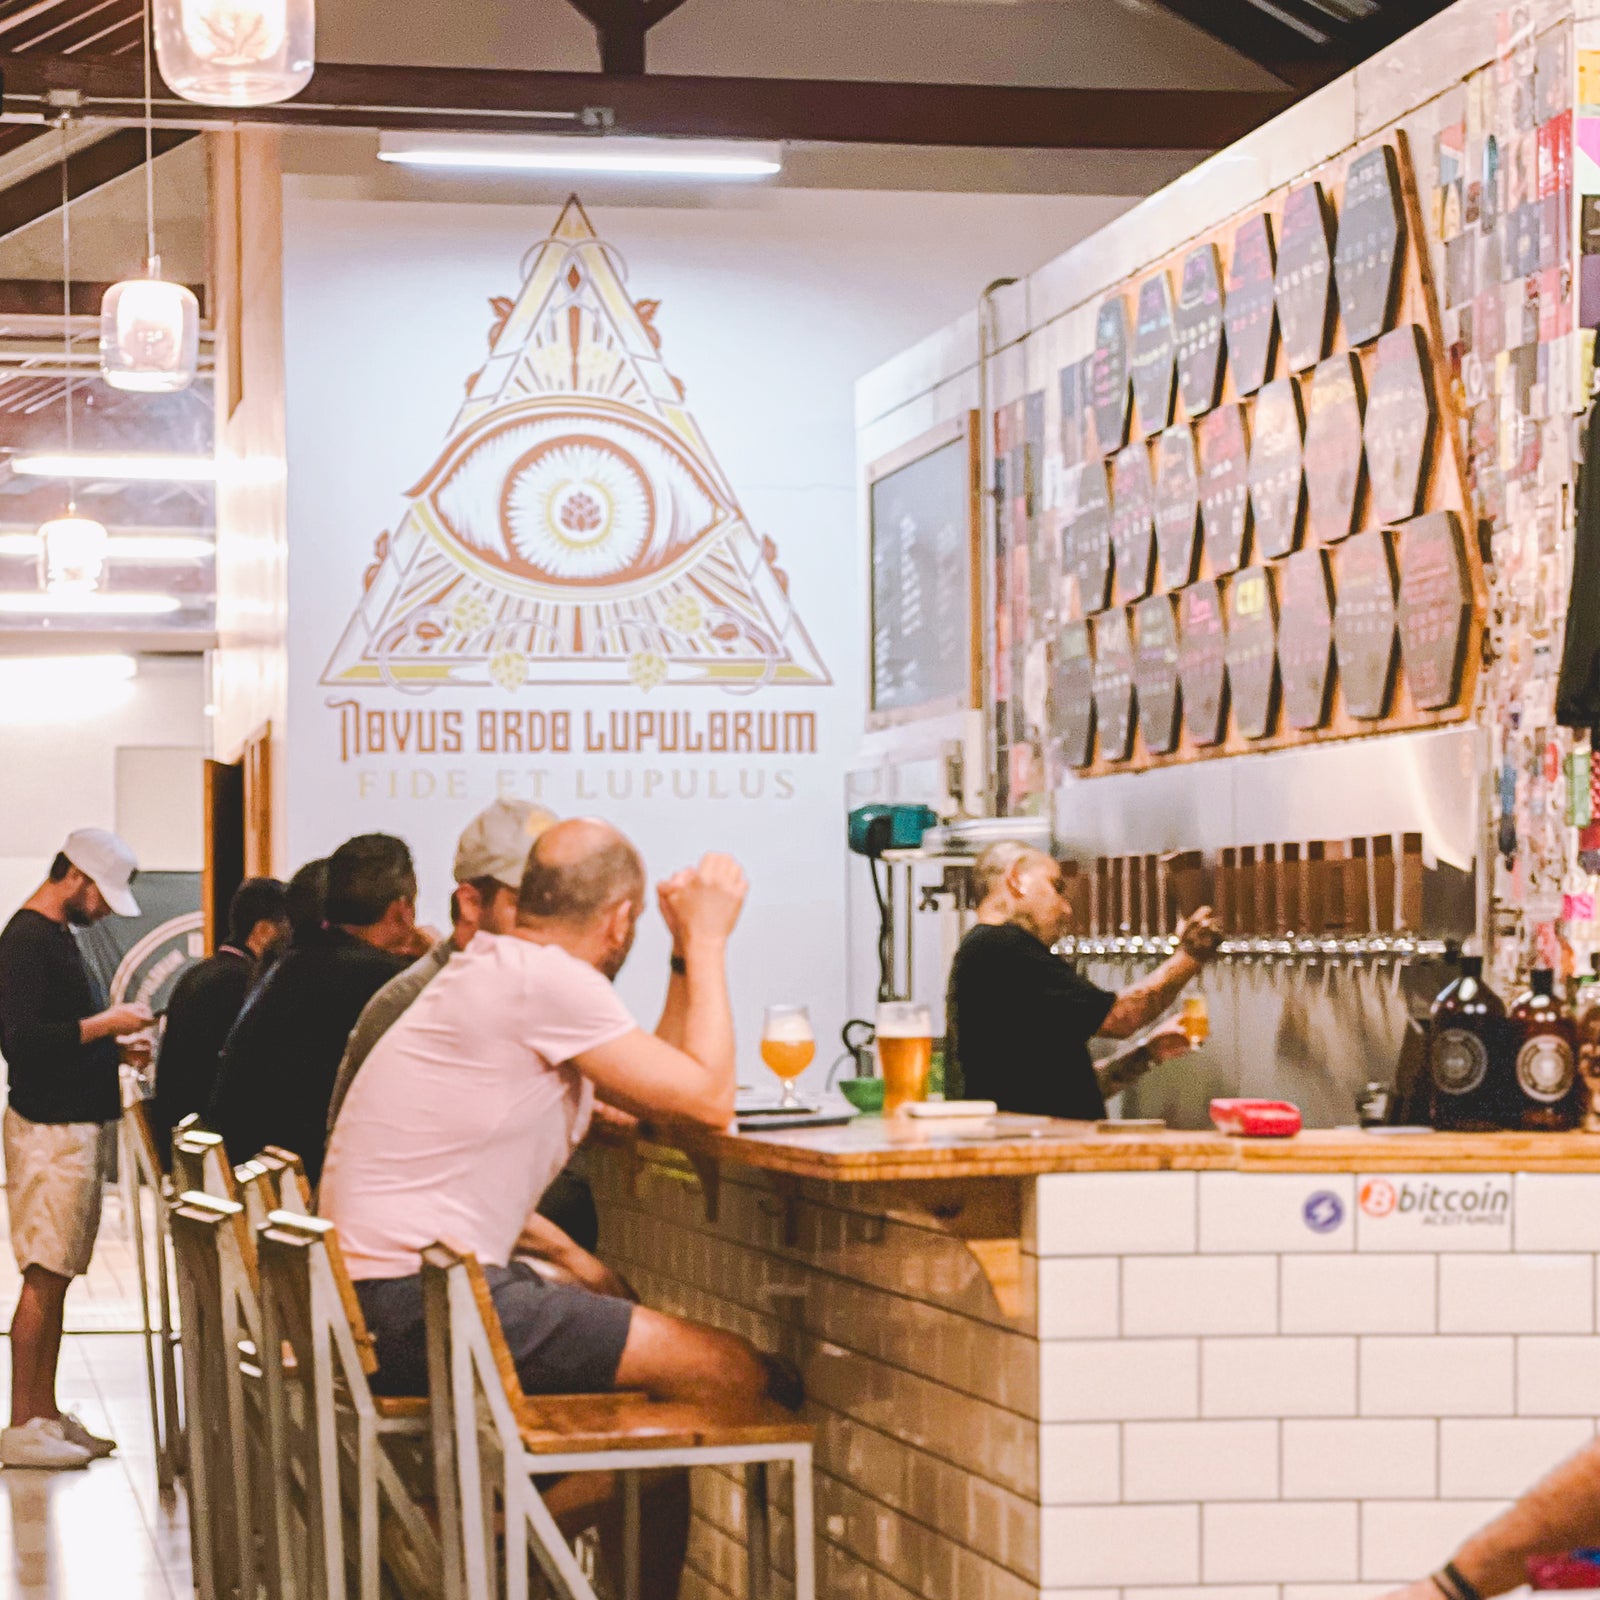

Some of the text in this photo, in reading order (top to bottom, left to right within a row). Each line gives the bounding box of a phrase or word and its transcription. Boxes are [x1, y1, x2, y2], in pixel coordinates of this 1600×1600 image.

[327, 699, 817, 763] NOVUS ORDO LUPULORUM
[357, 769, 796, 799] FIDE ET LUPULUS
[1398, 1182, 1509, 1212] bitcoin
